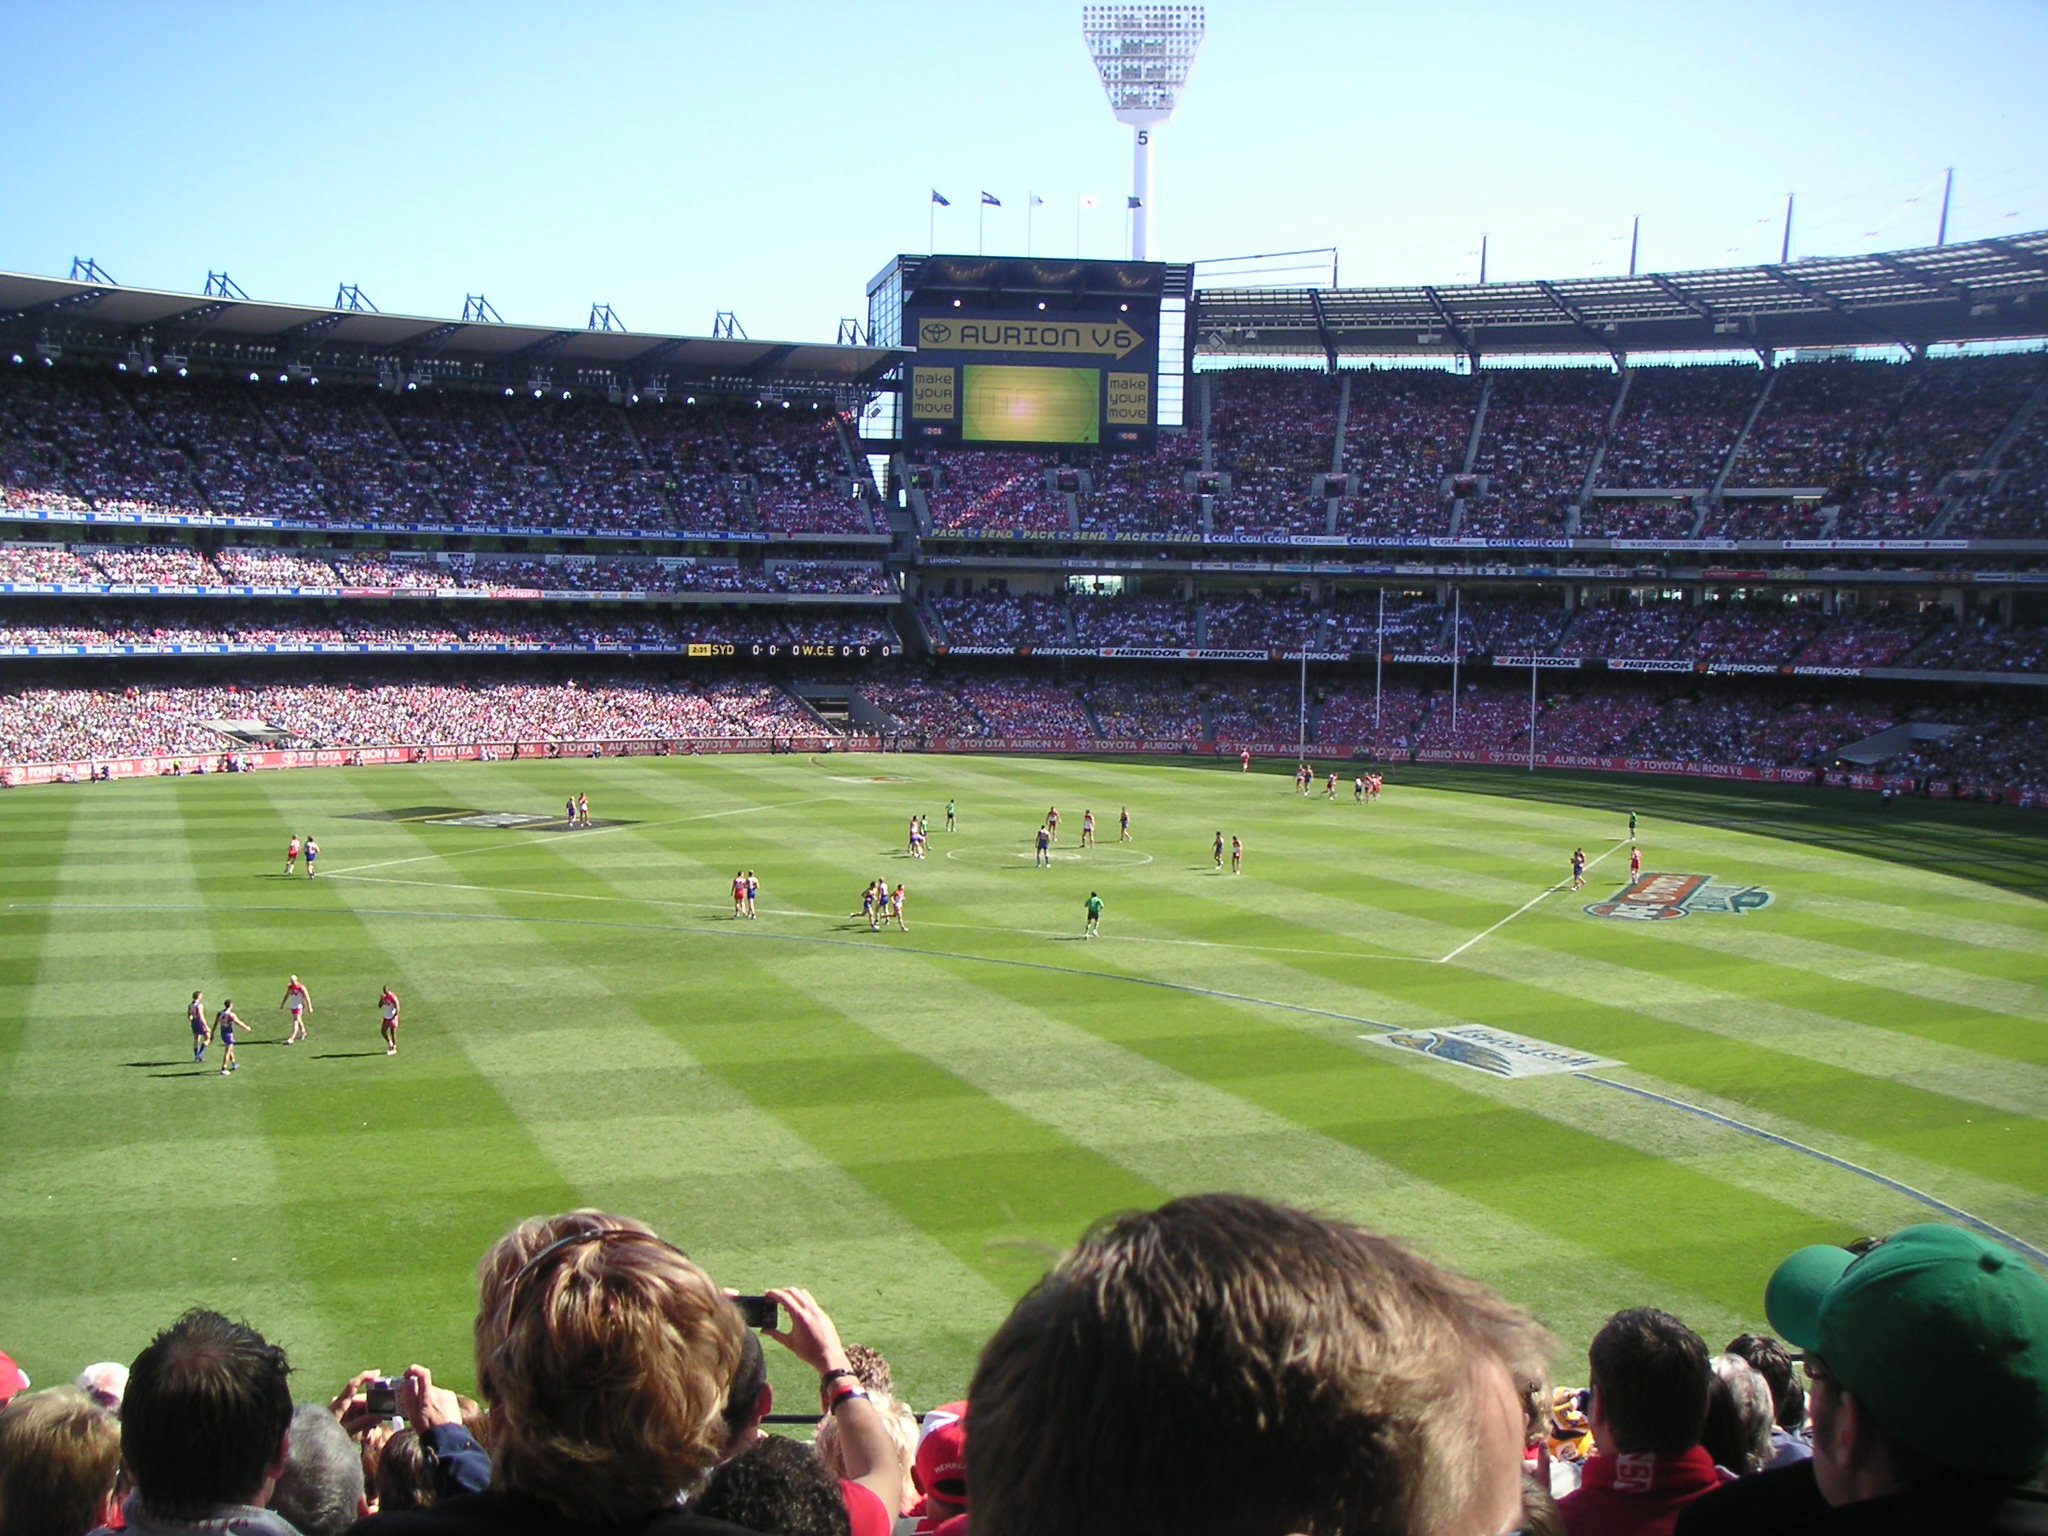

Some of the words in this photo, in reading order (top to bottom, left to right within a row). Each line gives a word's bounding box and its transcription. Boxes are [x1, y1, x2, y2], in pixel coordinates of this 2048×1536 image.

[1138, 131, 1148, 146] 5
[960, 325, 1080, 347] AURION
[1092, 330, 1132, 348] V6
[915, 373, 952, 384] make
[1110, 379, 1146, 390] make
[914, 403, 953, 413] move
[1109, 409, 1146, 419] move
[282, 520, 304, 529] Herald
[305, 520, 318, 529] Sun
[327, 521, 349, 530] Herald
[351, 522, 364, 530] Sun
[418, 523, 440, 532] Herald
[441, 524, 455, 532] Sun
[463, 524, 485, 533] Herald
[487, 525, 500, 533] Sun
[508, 525, 530, 534] Herald
[531, 526, 544, 534] Sun
[552, 527, 574, 535] Herald
[575, 527, 588, 536] Sun
[597, 528, 618, 537] Herald
[620, 529, 633, 537] Sun
[931, 529, 965, 538] PACK
[641, 530, 663, 538] Herald
[664, 530, 677, 539] Sun
[684, 530, 706, 539] Herald
[707, 531, 720, 540] Sun
[728, 531, 750, 540] Herald
[751, 532, 765, 540] Sun
[979, 530, 1013, 539] SEND
[1023, 531, 1055, 539] PACK
[1072, 531, 1107, 540] SEND
[1115, 533, 1148, 541] PACK
[1166, 534, 1201, 542] SEND
[712, 644, 735, 655] SYD
[964, 739, 1006, 748] TOYOTA
[1011, 739, 1051, 749] AURION
[1053, 740, 1067, 749] V6
[1095, 740, 1137, 750] TOYOTA
[1142, 741, 1183, 750] AURION
[1185, 741, 1198, 751] V6
[1234, 743, 1275, 753] TOYOTA
[1324, 745, 1337, 754] V6
[386, 748, 400, 758] V6
[1463, 751, 1476, 760] V6
[1553, 755, 1597, 766] AURION
[1601, 758, 1612, 767] V6
[1643, 760, 1684, 772] TOYOTA
[1730, 765, 1743, 776] V6
